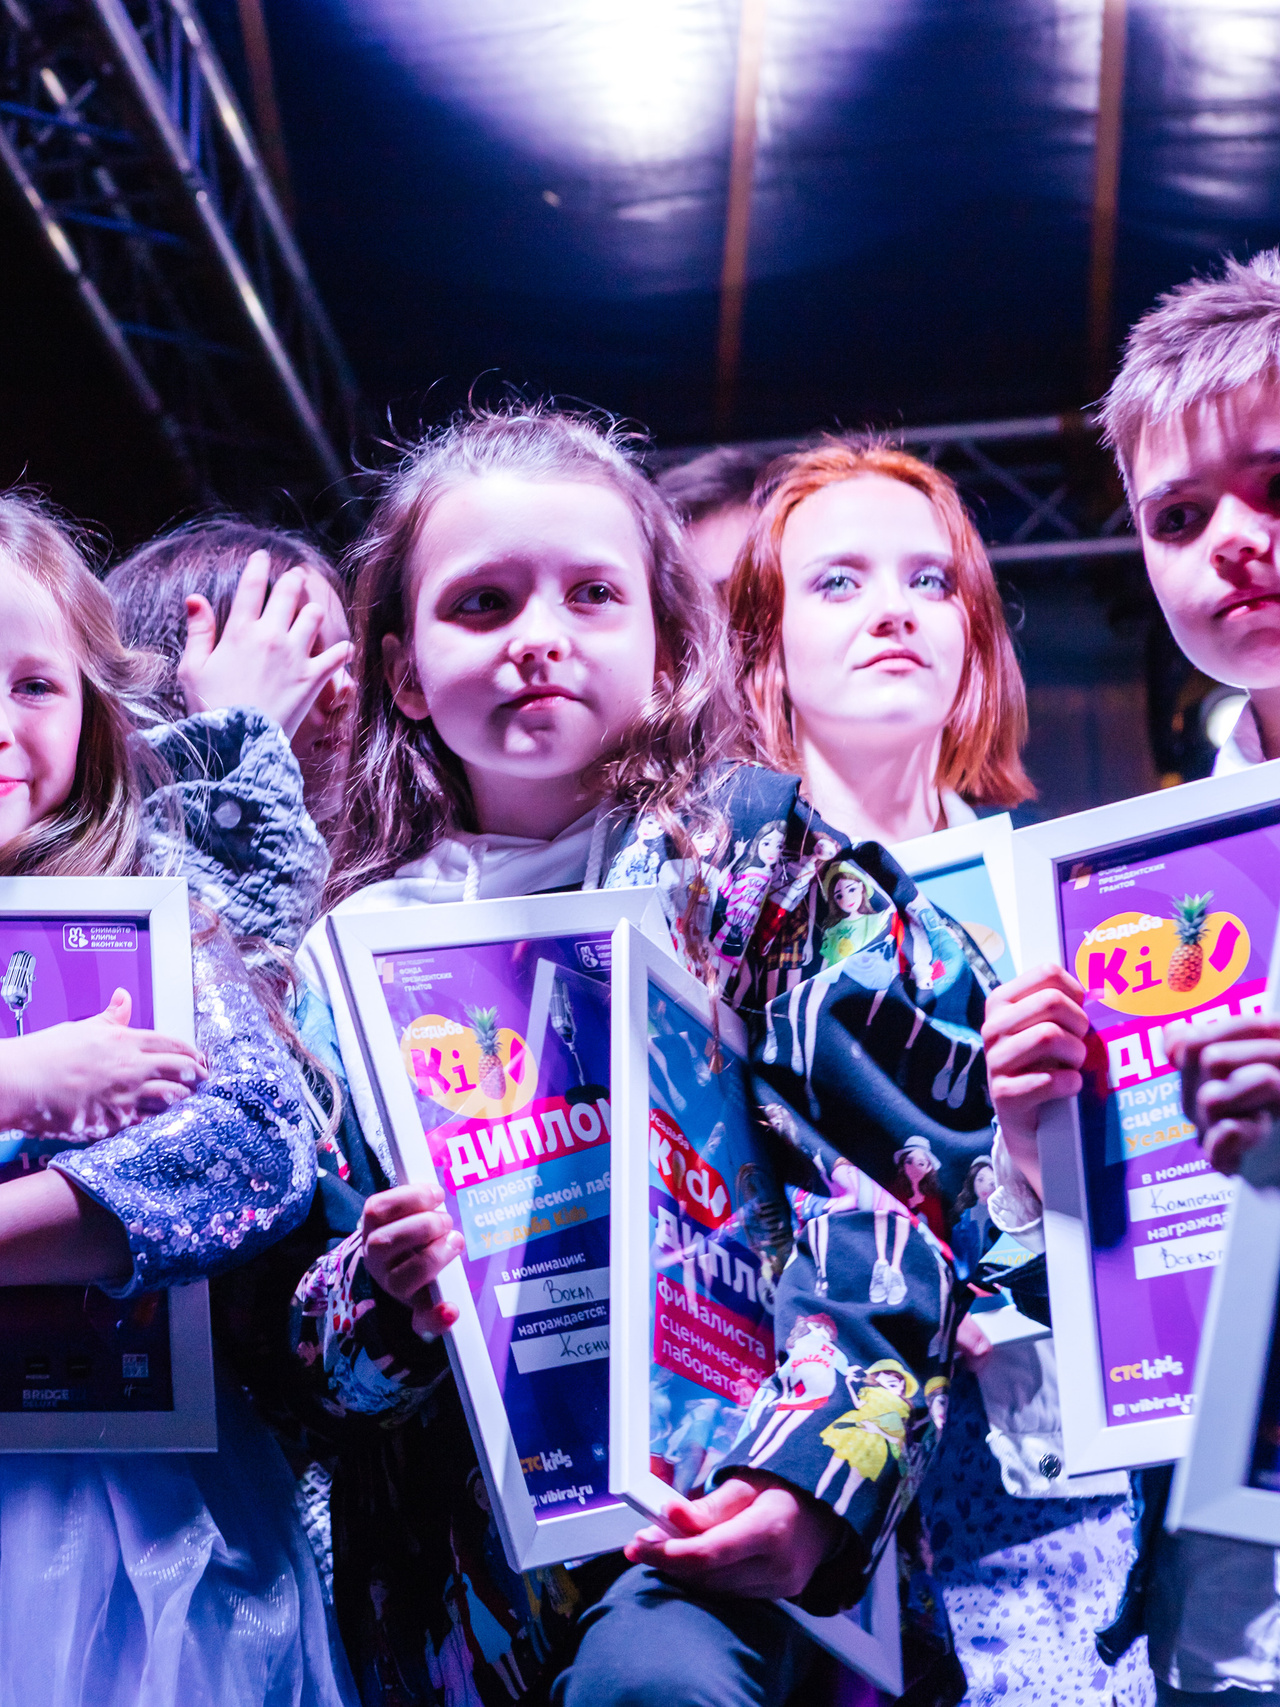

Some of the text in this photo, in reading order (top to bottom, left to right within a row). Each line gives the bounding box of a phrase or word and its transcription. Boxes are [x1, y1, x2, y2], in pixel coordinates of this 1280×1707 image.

[1083, 914, 1163, 946] Усадьба
[401, 1020, 464, 1040] Усадьба
[1125, 1122, 1196, 1152] Усадь
[466, 1174, 543, 1207] Лауреата
[474, 1182, 583, 1227] сценической
[1150, 1189, 1235, 1214] Композито
[480, 1217, 551, 1249] Усадьба
[1147, 1211, 1230, 1241] награжда
[512, 1252, 586, 1279] номинации:
[543, 1279, 594, 1303] Вокал
[517, 1305, 607, 1336] награждается:
[658, 1277, 766, 1360] финалиста
[560, 1333, 610, 1357] Ксени
